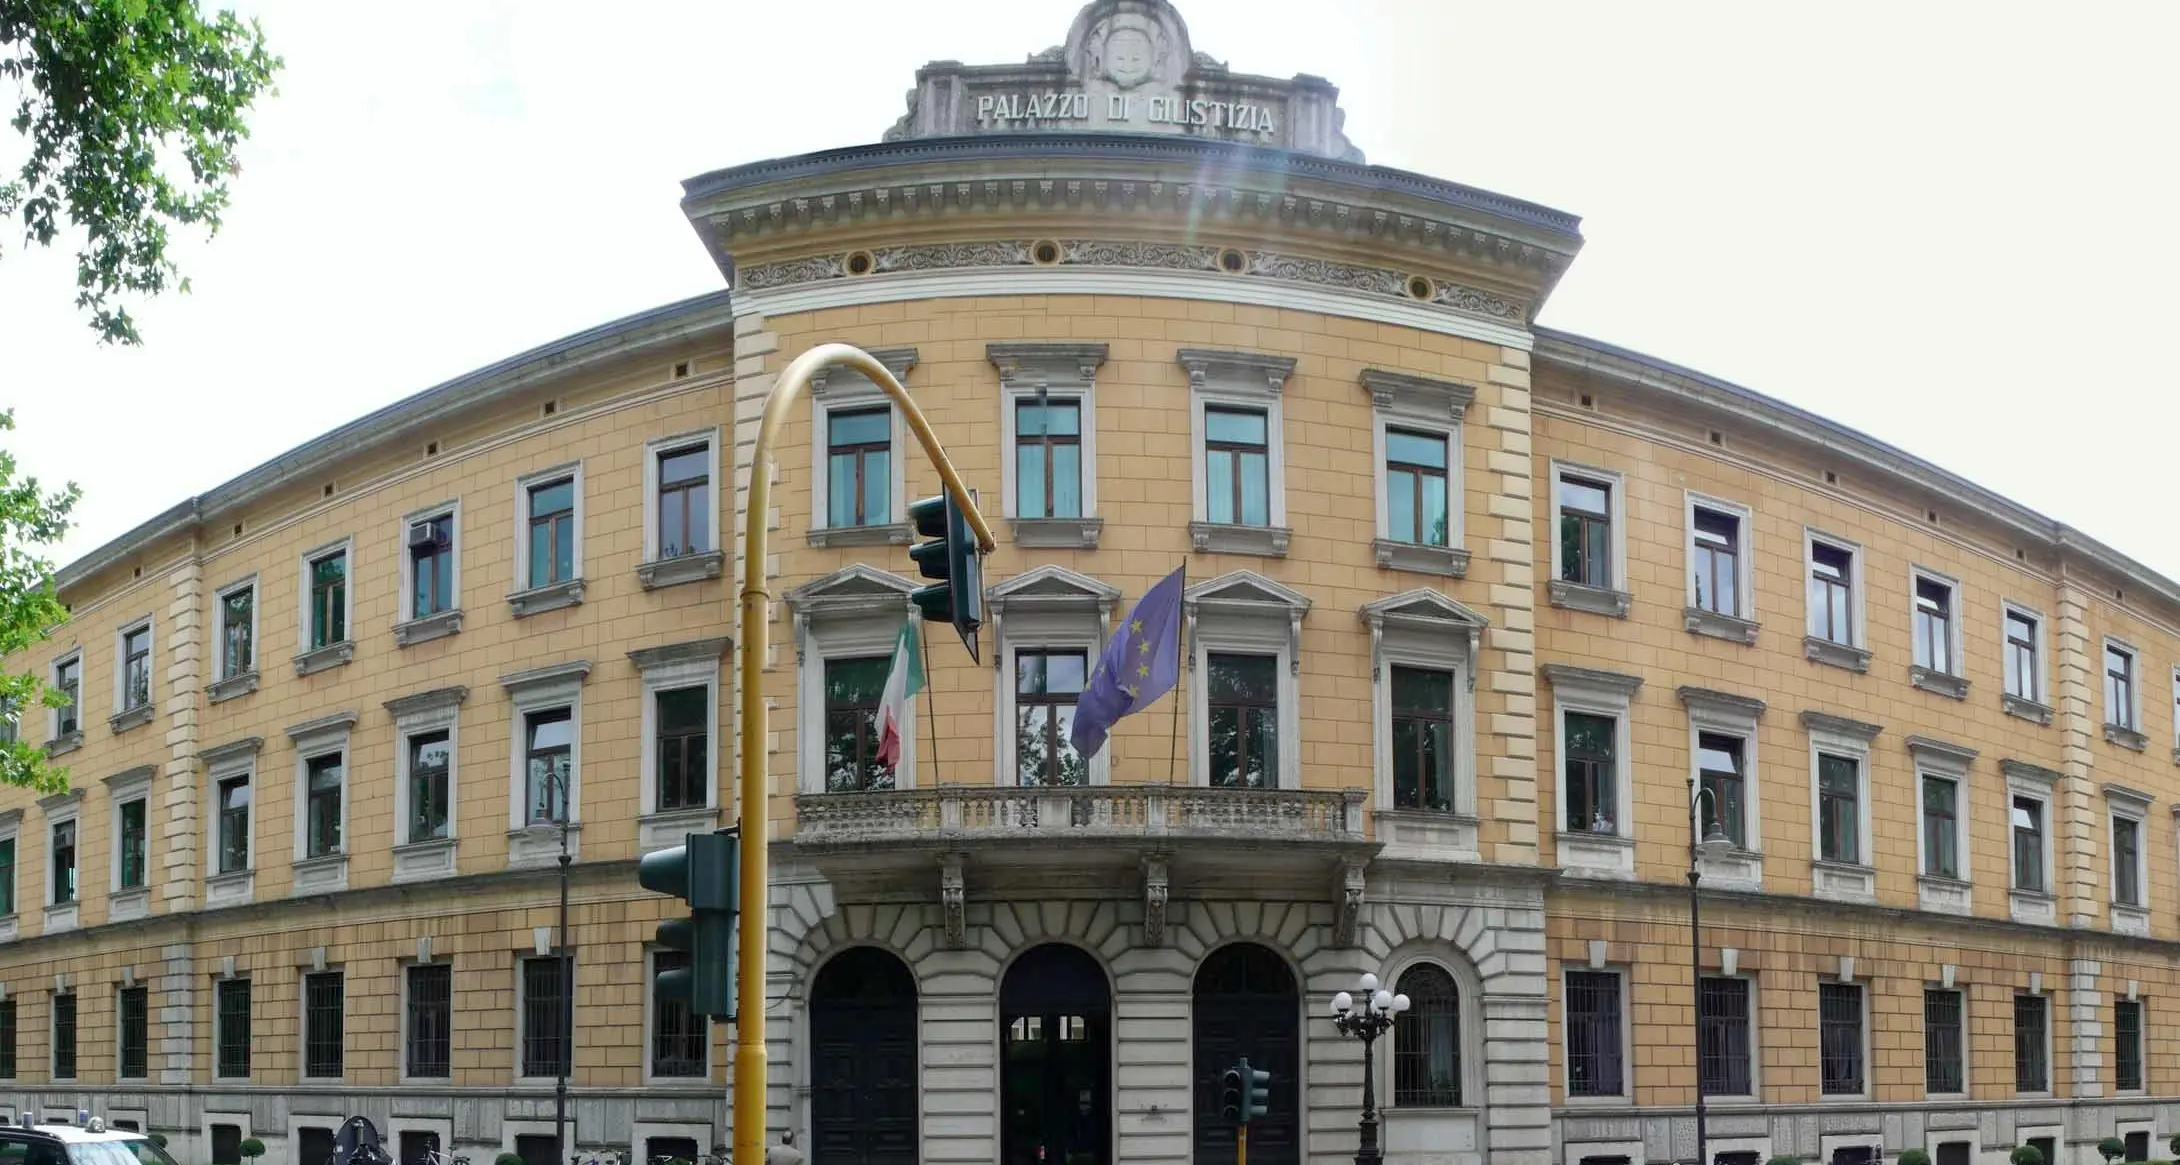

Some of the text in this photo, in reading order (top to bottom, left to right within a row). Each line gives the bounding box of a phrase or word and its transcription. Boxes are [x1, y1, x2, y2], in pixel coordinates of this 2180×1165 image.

[977, 93, 1275, 133] PALAZZO DI GIUSTIZIA
